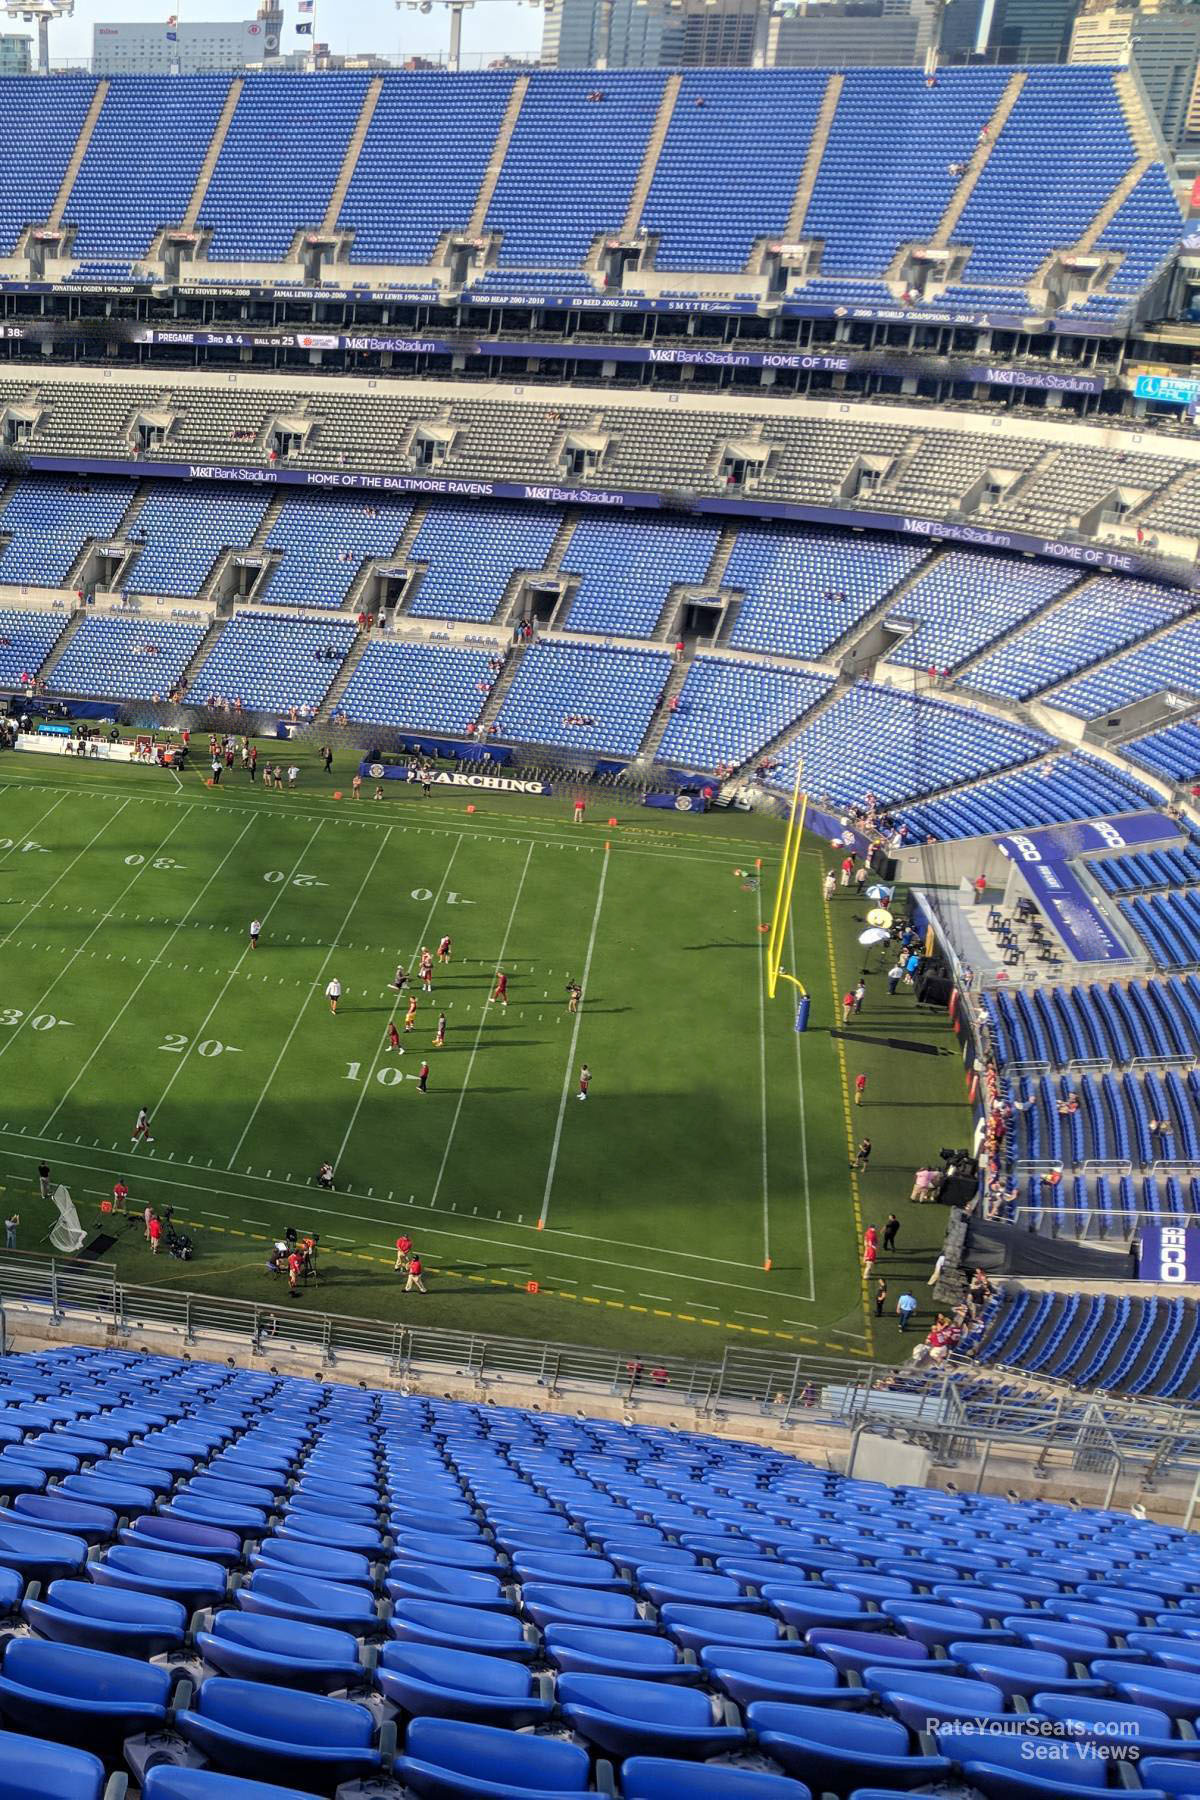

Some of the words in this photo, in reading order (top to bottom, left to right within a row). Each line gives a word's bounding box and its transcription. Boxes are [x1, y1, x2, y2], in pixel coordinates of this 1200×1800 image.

[82, 285, 103, 293] OGDEN
[178, 287, 194, 295] MATT
[273, 290, 293, 298] JAMAL
[294, 290, 313, 298] LEWIS
[384, 293, 403, 301] LEWIS
[472, 295, 490, 303] TODD
[572, 298, 582, 306] ED
[583, 298, 601, 306] REED
[602, 299, 638, 307] 2002-2012
[668, 302, 708, 310] SMYTH
[878, 310, 904, 319] WORLD
[906, 312, 950, 321] CHAMPIONS
[955, 314, 975, 322] 2012
[158, 333, 194, 343] PREGAME
[207, 335, 223, 344] 3RD
[226, 335, 233, 344] &
[235, 335, 243, 344] 4
[282, 336, 294, 346] 25
[345, 337, 369, 349] M&T
[370, 339, 394, 350] Bank
[395, 340, 435, 351] Stadium
[648, 350, 677, 361] M&T
[677, 351, 704, 362] Bank
[705, 352, 750, 365] Stadium
[762, 355, 800, 367] HOME
[801, 357, 820, 368] OF
[823, 358, 847, 369] THE
[986, 368, 1017, 382] M&T
[1017, 371, 1049, 386] Bank
[1049, 375, 1094, 391] Stadium
[189, 466, 214, 477] M&T
[214, 468, 238, 479] Bank
[239, 469, 277, 481] Stadium
[307, 473, 339, 484] HOME
[342, 475, 357, 485] OF
[360, 476, 381, 487] THE
[383, 478, 446, 491] BALTIMORE
[448, 482, 493, 494] RAVENS
[524, 486, 553, 498] M&T
[553, 488, 581, 500] Bank
[581, 491, 623, 503] Stadium
[903, 519, 933, 532] M&T
[933, 523, 961, 537] Bank
[961, 529, 1011, 545] Stadium
[1044, 542, 1081, 559] HOME
[1084, 550, 1104, 561] OF
[1106, 554, 1132, 569] THE
[263, 871, 318, 887] 20
[158, 1034, 224, 1057] 20
[341, 1062, 403, 1086] 10
[1161, 1227, 1186, 1283] GEICO
